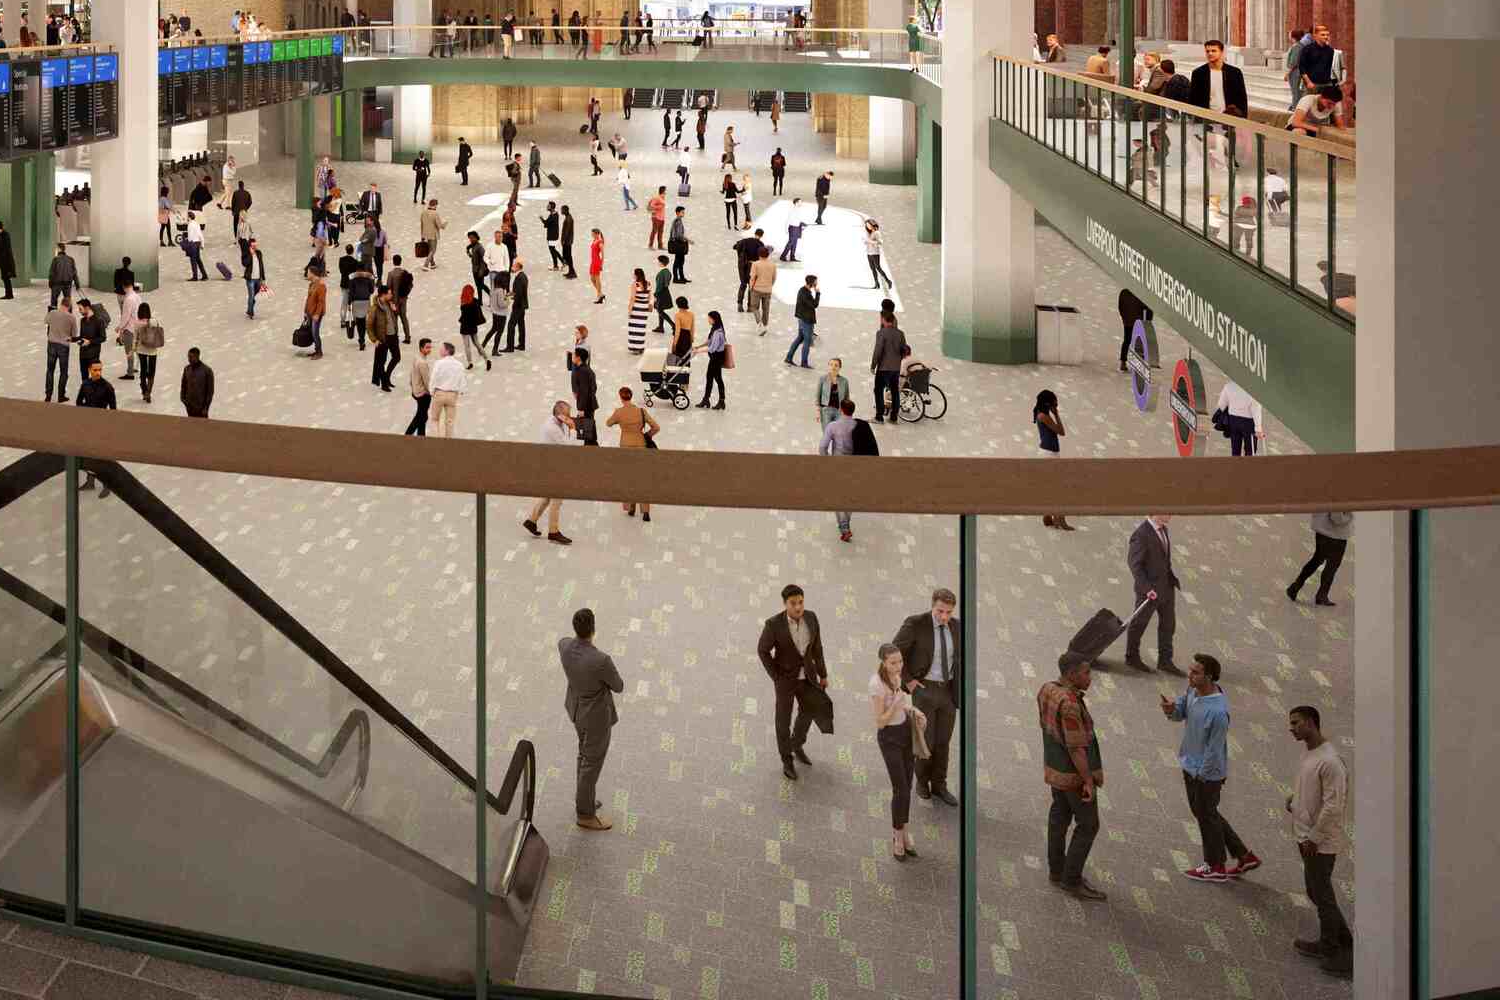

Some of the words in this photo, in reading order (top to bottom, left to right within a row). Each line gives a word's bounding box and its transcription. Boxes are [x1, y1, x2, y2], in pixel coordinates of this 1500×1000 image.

[1086, 216, 1118, 263] LIVERPOOL
[1119, 240, 1145, 284] STREET
[1145, 259, 1215, 339] UNDERGROUND
[1217, 311, 1267, 383] STATION
